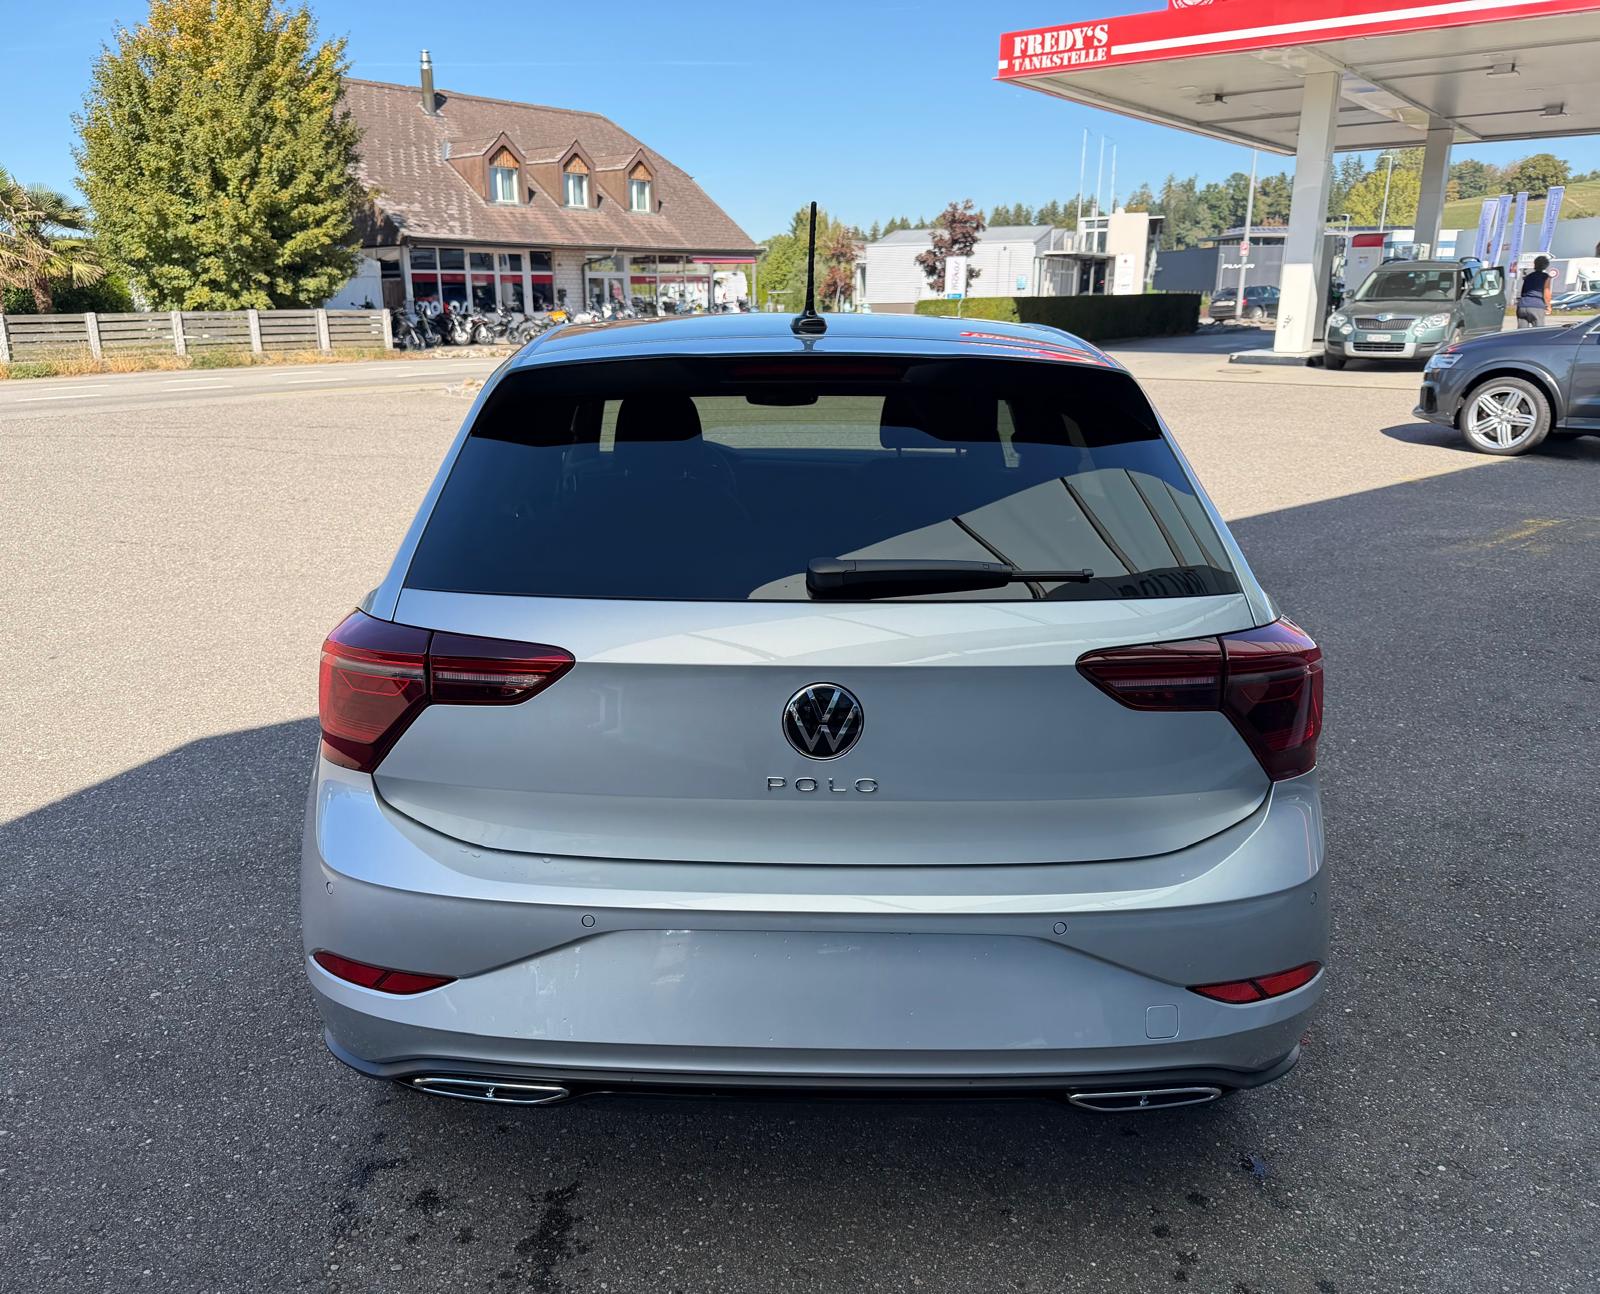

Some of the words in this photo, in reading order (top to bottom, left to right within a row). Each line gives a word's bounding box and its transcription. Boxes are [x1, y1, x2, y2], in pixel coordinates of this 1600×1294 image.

[1013, 24, 1109, 57] FREDY'S
[1012, 47, 1108, 72] TANKSTELLE
[766, 776, 879, 793] POLO
